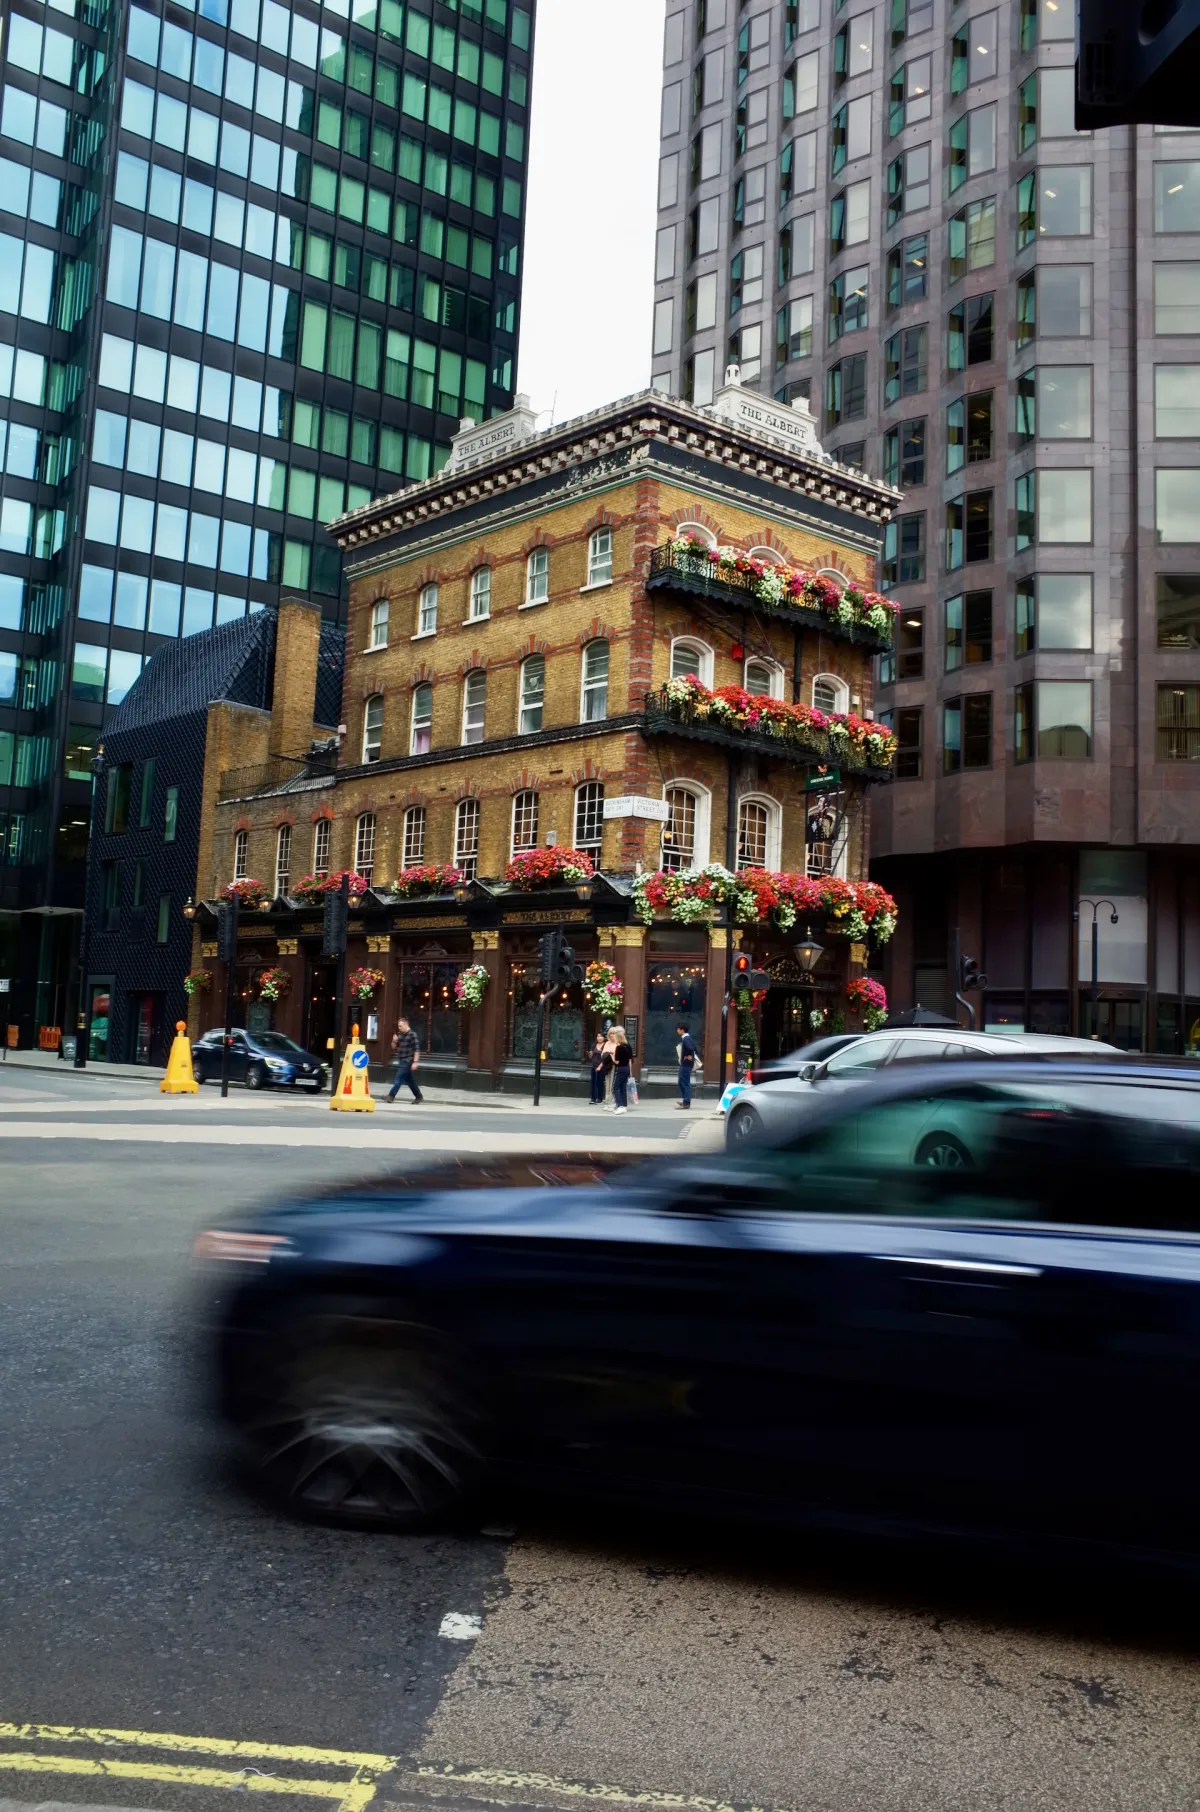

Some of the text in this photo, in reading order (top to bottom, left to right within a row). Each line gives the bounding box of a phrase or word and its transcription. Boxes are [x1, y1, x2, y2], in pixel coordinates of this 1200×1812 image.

[741, 405, 805, 438] THE ALBERT
[459, 427, 514, 456] THE ALBERT
